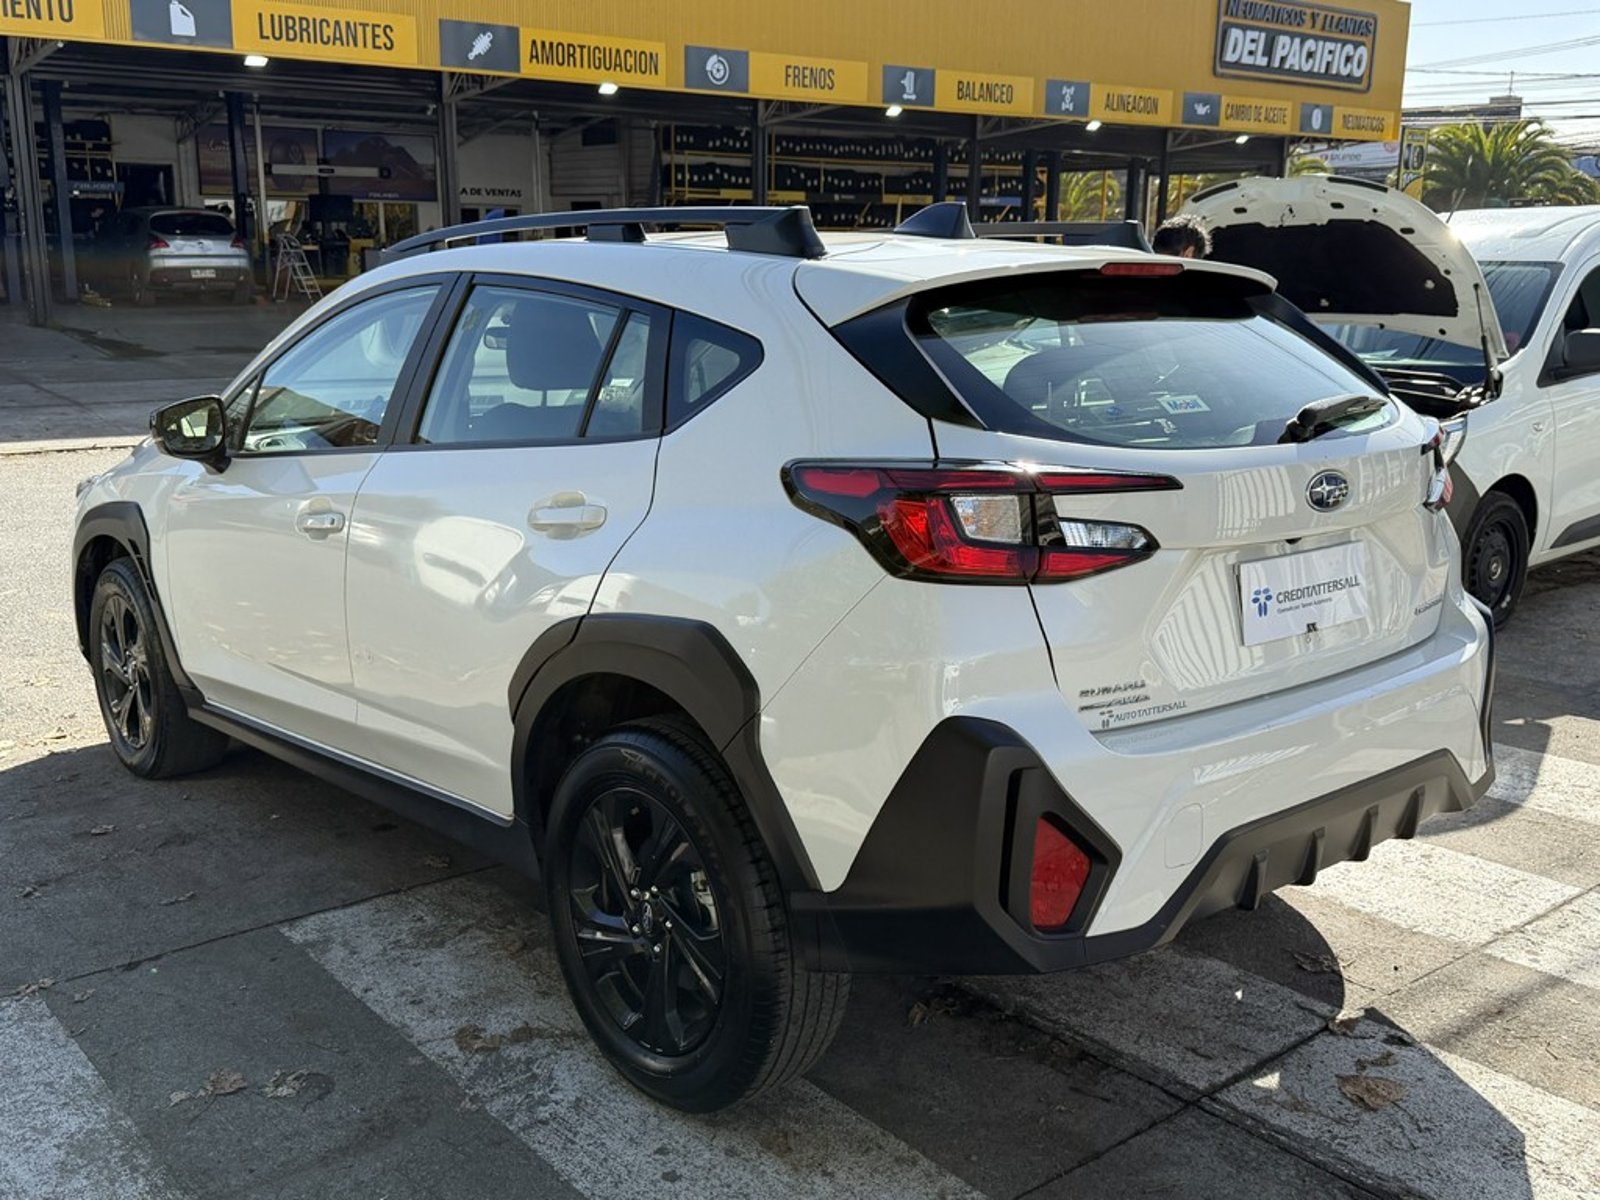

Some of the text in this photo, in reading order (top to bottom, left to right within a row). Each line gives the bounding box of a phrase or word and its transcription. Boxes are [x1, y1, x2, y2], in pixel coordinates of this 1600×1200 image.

[257, 12, 395, 51] LUBRICANTES
[1227, 0, 1373, 36] NEUMATICOS Y LLANTAS
[529, 38, 659, 76] AMORTIGUACION
[1223, 27, 1368, 78] DEL PACIFICO
[784, 64, 836, 91] FRENOS
[957, 80, 1014, 105] BALANCEO
[1104, 92, 1159, 116] ALINEACION
[1224, 102, 1288, 125] CAMBIO DE ACEITE
[1342, 113, 1386, 134] NEUMATICOS
[470, 187, 481, 196] DE
[485, 187, 523, 198] VENTAS
[1276, 575, 1360, 604] CREDITATTERSALL
